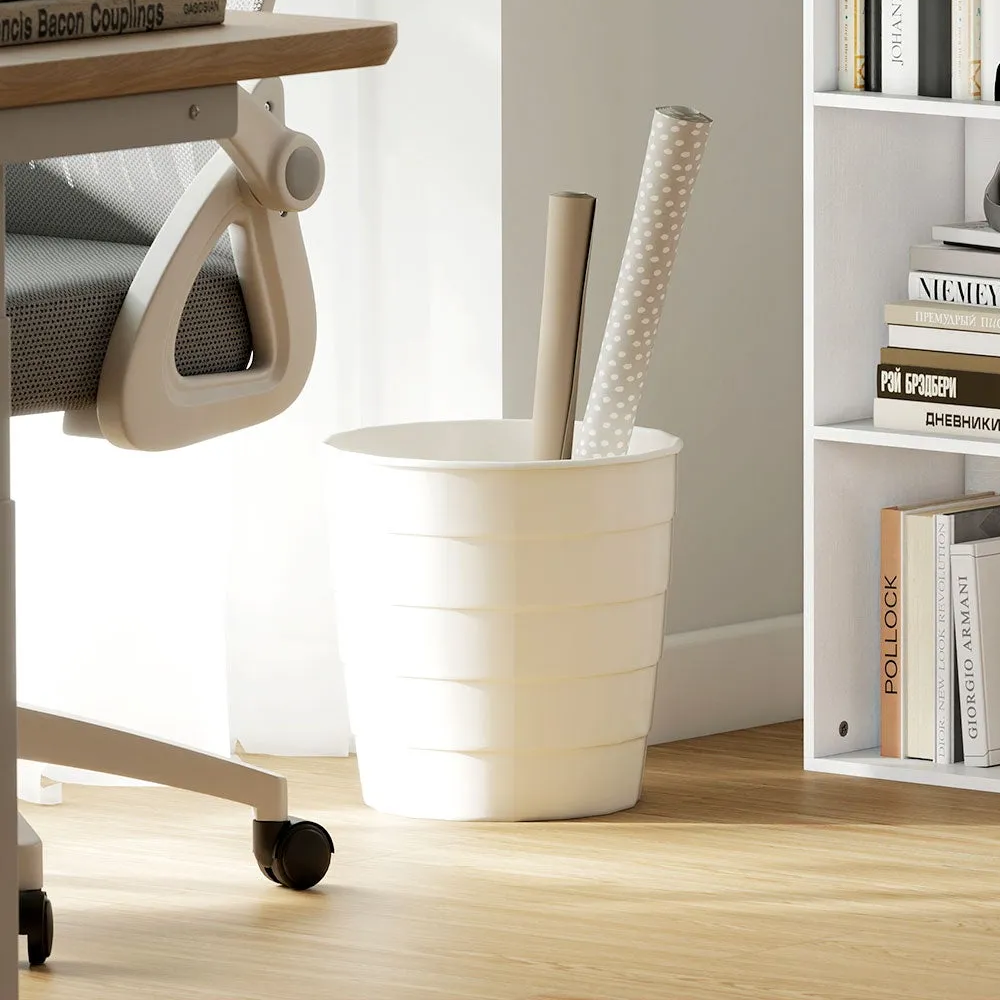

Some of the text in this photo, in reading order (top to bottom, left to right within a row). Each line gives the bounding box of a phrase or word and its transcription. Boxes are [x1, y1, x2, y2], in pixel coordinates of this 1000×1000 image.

[38, 8, 84, 38] Bacon
[90, 0, 165, 34] Couplings
[881, 367, 957, 398] РЭЙ БРЭДБЕРИ
[926, 412, 1000, 432] ДНЕВНИКИ
[884, 575, 898, 694] POLLOCK
[958, 576, 978, 739] GIORGIO ARMANI
